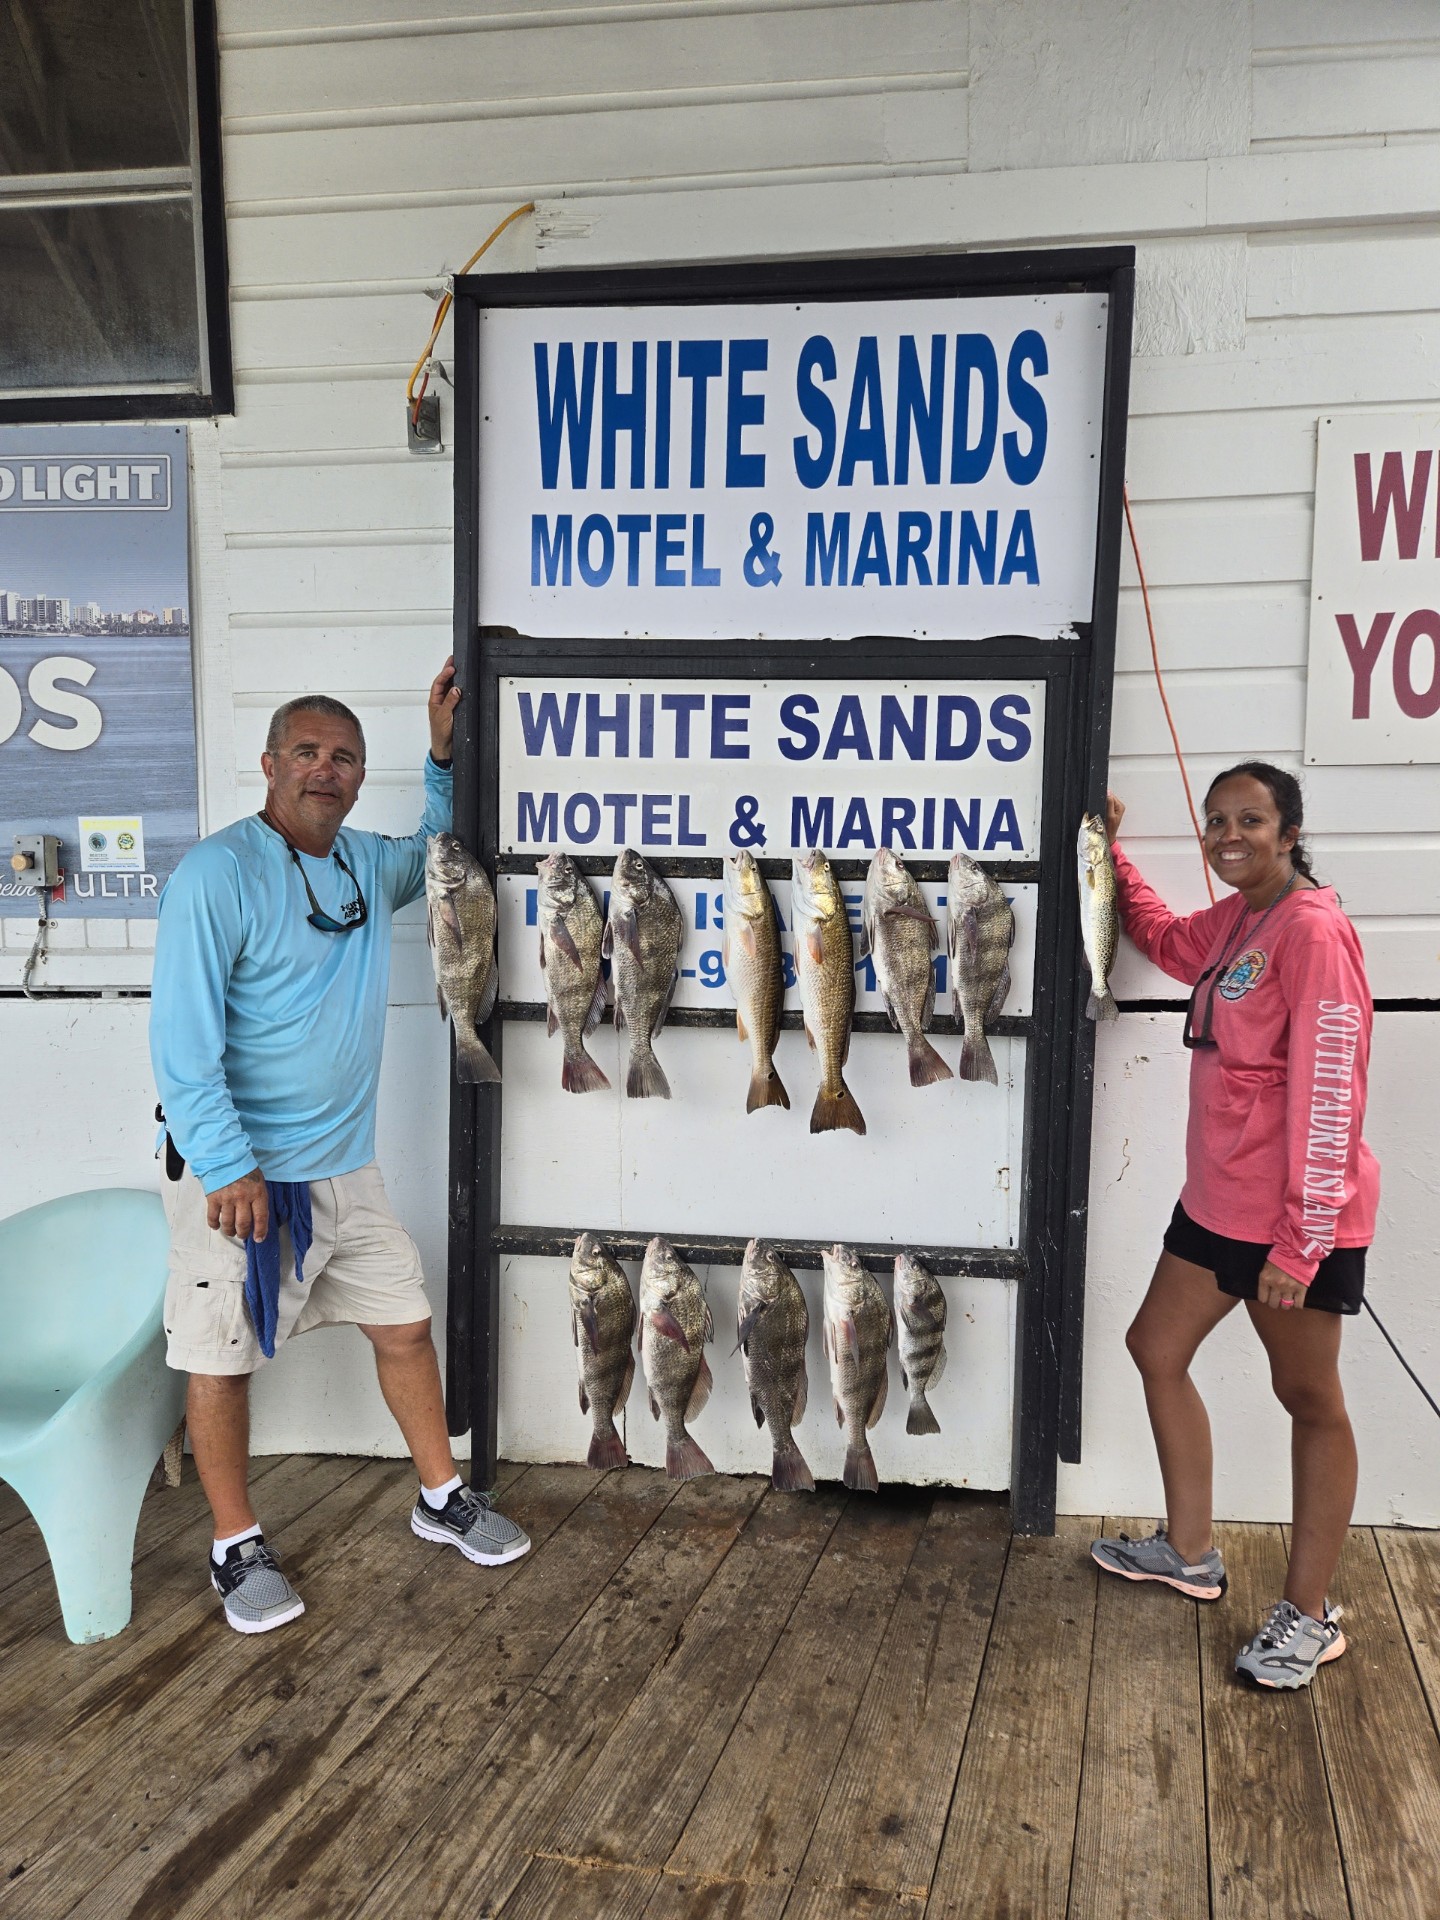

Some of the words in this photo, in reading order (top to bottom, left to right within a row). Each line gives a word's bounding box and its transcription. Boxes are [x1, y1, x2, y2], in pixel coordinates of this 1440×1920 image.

[533, 338, 769, 490] WHITE
[793, 329, 1049, 489] SANDS
[22, 465, 160, 501] LIGHT
[1353, 449, 1440, 562] W
[530, 513, 721, 587] MOTEL
[743, 511, 782, 588] &
[804, 509, 1040, 587] MARINA
[517, 692, 752, 760] WHITE
[778, 693, 1032, 762] SANDS
[517, 791, 707, 847] MOTEL
[728, 794, 767, 848] &
[791, 795, 1024, 850] MARINA
[74, 873, 172, 898] ULTR
[1314, 1000, 1361, 1083] SOUTH
[1306, 1084, 1352, 1163] PADRE
